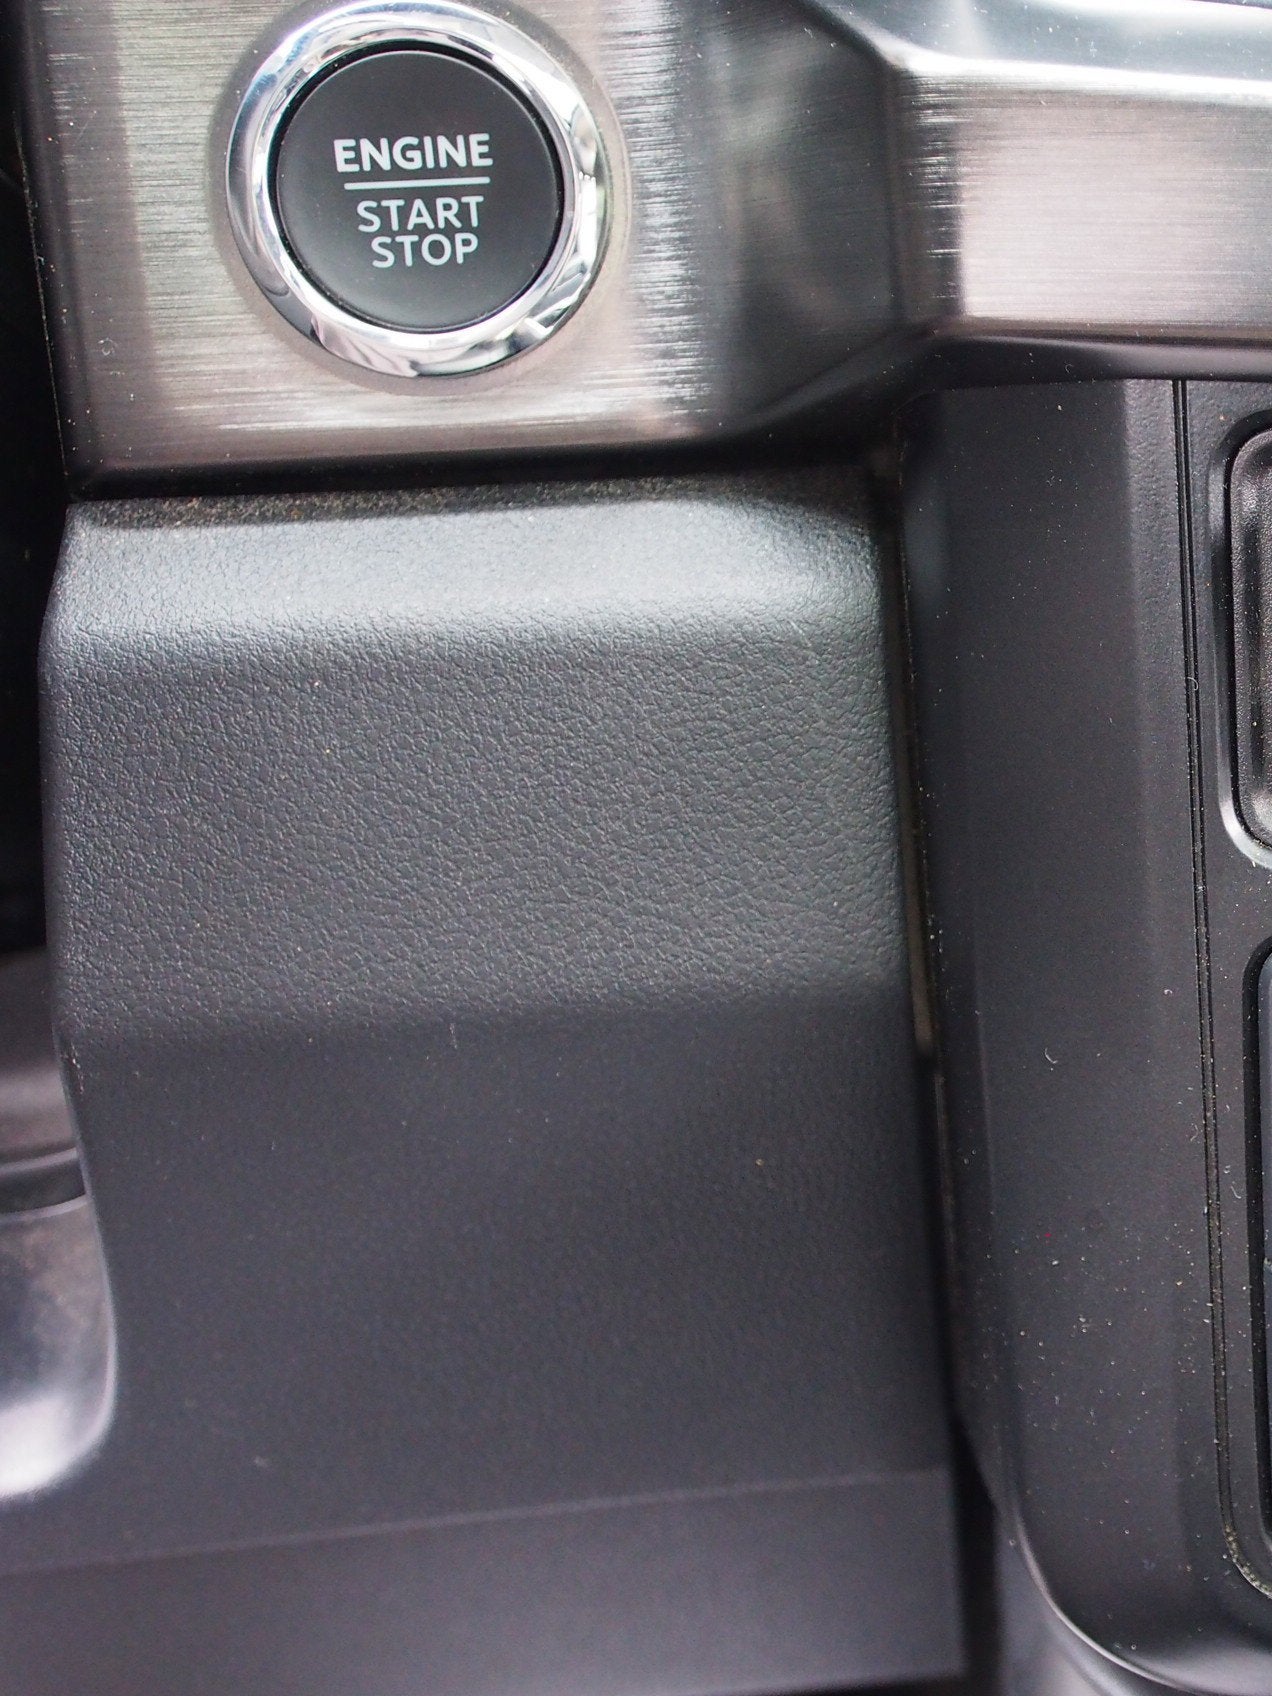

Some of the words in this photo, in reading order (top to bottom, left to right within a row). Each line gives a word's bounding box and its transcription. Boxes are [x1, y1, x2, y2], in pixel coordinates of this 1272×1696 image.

[334, 133, 494, 173] ENGINE
[357, 196, 484, 232] START
[372, 233, 479, 269] STOP
